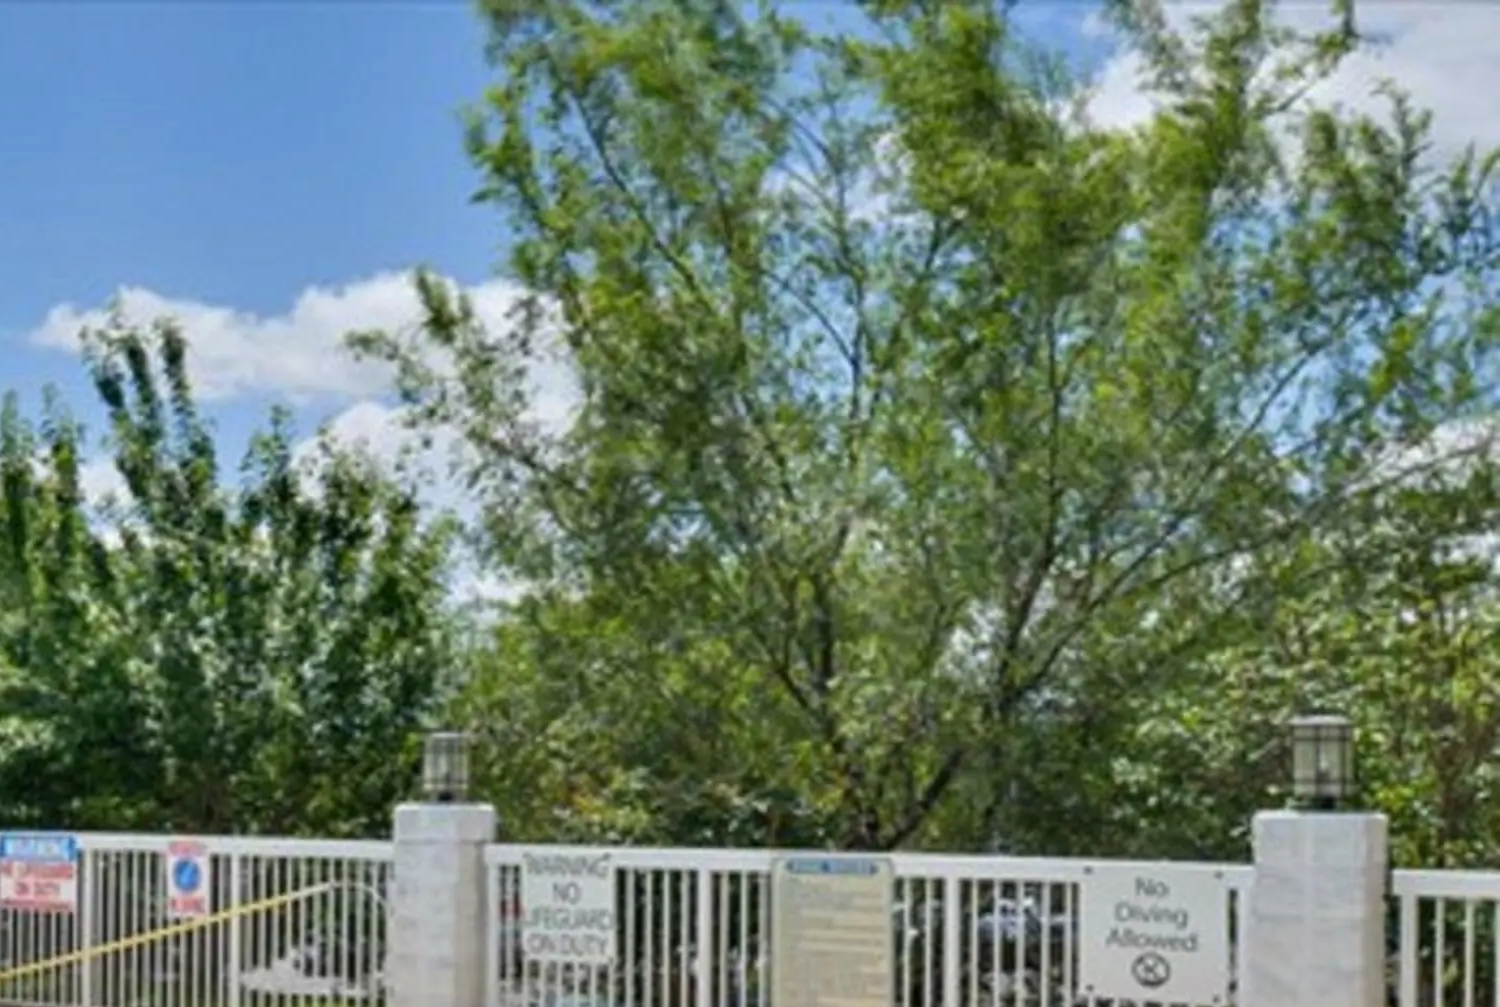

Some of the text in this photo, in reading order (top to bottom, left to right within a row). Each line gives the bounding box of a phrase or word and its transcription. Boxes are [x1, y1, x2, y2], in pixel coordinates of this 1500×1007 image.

[552, 881, 581, 904] NO
[1135, 876, 1169, 897] No
[1115, 901, 1188, 930] Diving
[527, 932, 609, 956] ON DUTY
[1106, 927, 1199, 952] Allowed
